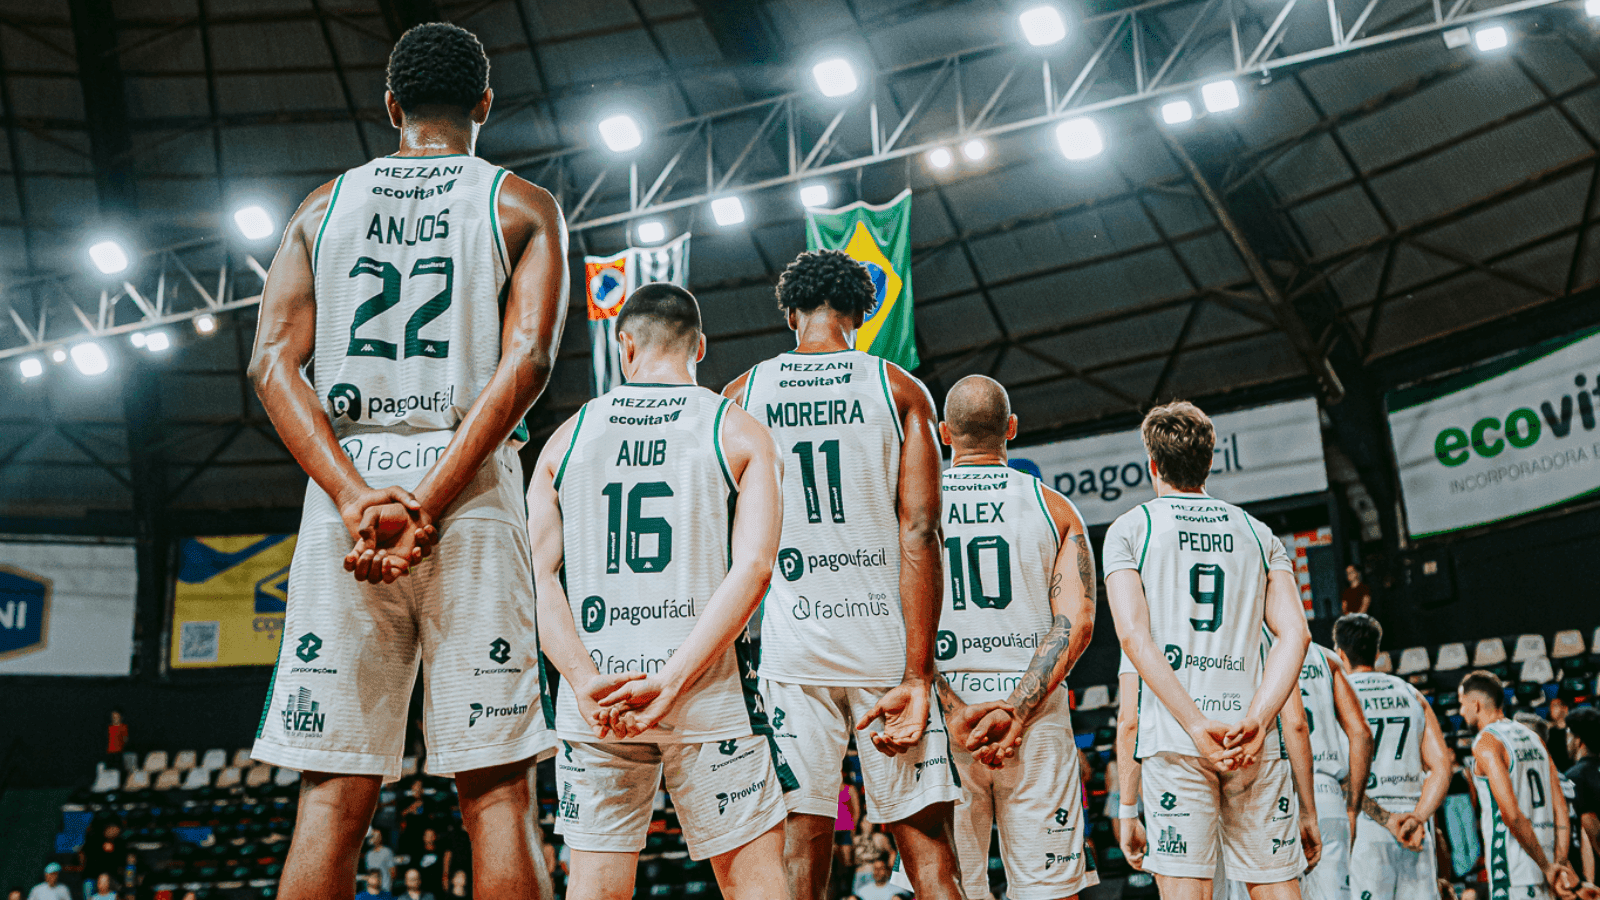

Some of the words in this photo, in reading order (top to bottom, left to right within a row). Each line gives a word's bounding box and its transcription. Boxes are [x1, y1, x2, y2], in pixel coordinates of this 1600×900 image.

[374, 165, 464, 179] MEZZANI
[372, 185, 434, 200] ecovita
[366, 208, 450, 246] ANJOS
[346, 256, 454, 361] 22
[780, 362, 853, 372] MEZZANI
[779, 376, 834, 388] ecovita
[611, 397, 687, 409] MEZZANI
[766, 399, 865, 428] MOREIRA
[609, 414, 663, 426] ecovita
[367, 443, 446, 471] facim
[615, 439, 667, 467] AIUB
[792, 439, 846, 524] 11
[1450, 447, 1589, 495] INCORPORADORA
[948, 502, 1005, 524] ALEX
[601, 481, 675, 575] 16
[1178, 531, 1234, 553] PEDRO
[807, 547, 887, 574] pagoufácil
[944, 535, 1013, 611] 10
[815, 598, 889, 620] facimus
[1189, 563, 1225, 633] 9
[609, 597, 696, 626] pagoufácil
[607, 654, 667, 675] facim
[1185, 655, 1245, 671] pagoufácil
[1300, 665, 1323, 679] SON
[961, 673, 1022, 692] facim
[486, 703, 528, 718] Provém
[1365, 696, 1410, 710] ATERAN
[1367, 716, 1410, 761] 77
[730, 779, 766, 803] Provém
[1526, 768, 1545, 808] 0
